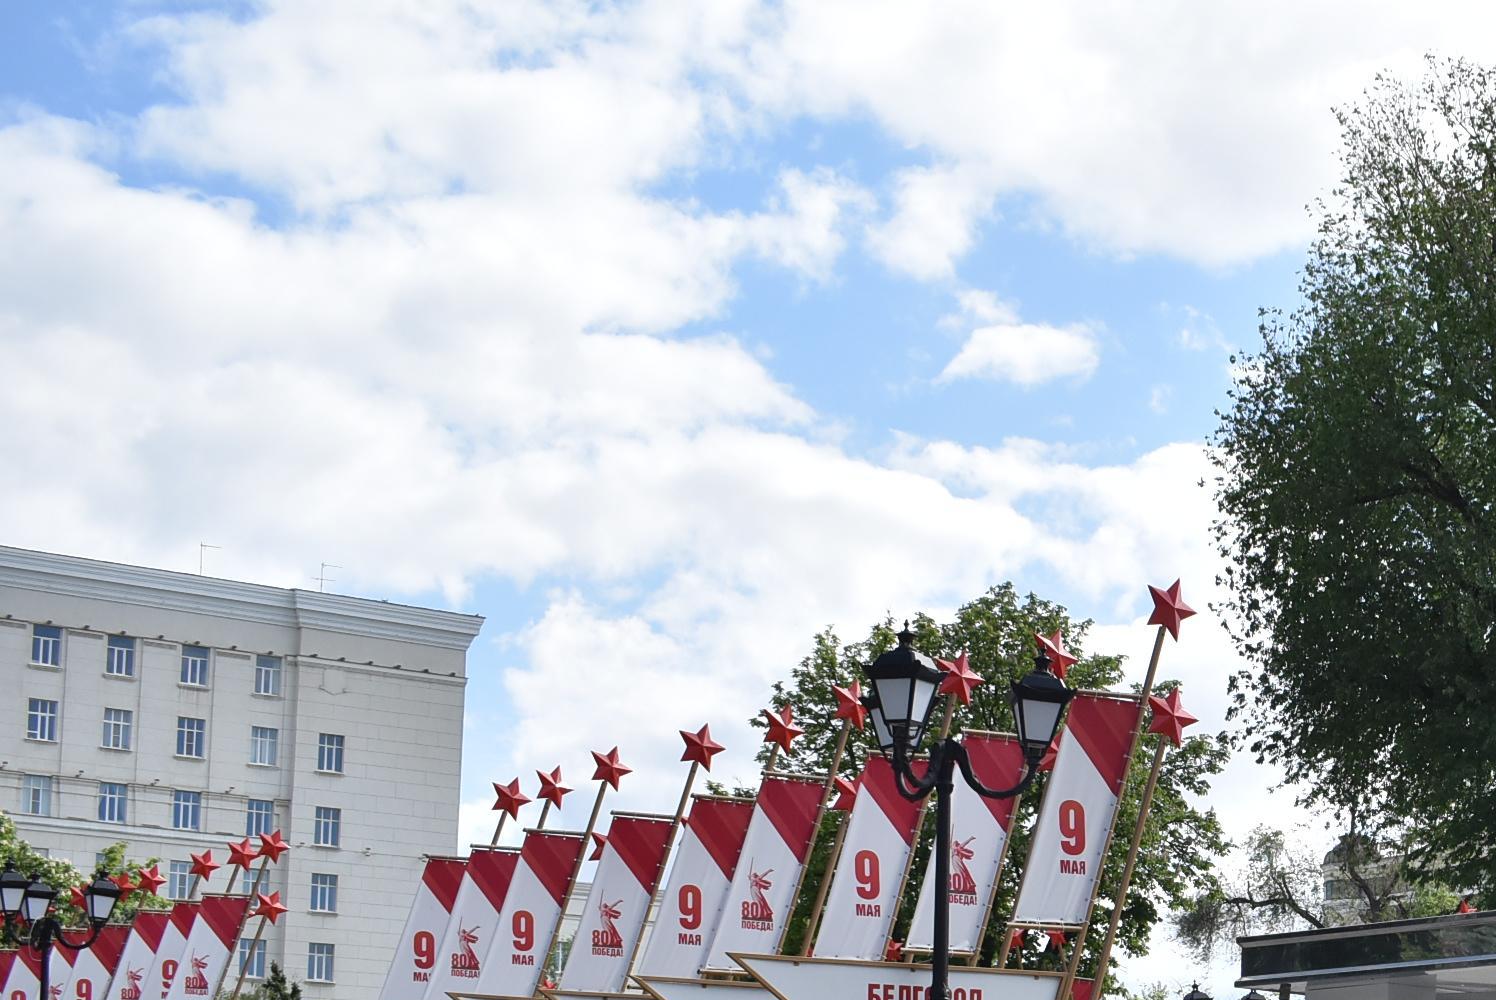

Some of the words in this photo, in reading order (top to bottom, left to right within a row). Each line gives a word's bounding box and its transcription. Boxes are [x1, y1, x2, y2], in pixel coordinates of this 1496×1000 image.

[1059, 800, 1086, 856] 9
[854, 850, 881, 900] 9
[1060, 860, 1086, 875] МАЯ
[679, 884, 702, 930] 9
[948, 894, 977, 905] ОБЕДА!
[742, 901, 758, 917] 80
[856, 903, 881, 917] МАЯ
[512, 910, 534, 951] 9
[741, 920, 774, 931] ПОБЕДА!
[592, 930, 607, 945] 80
[678, 933, 701, 946] МАЯ
[414, 931, 435, 969] 9
[451, 953, 467, 967] 80
[512, 954, 534, 966] МАЯ
[413, 972, 431, 982] МА
